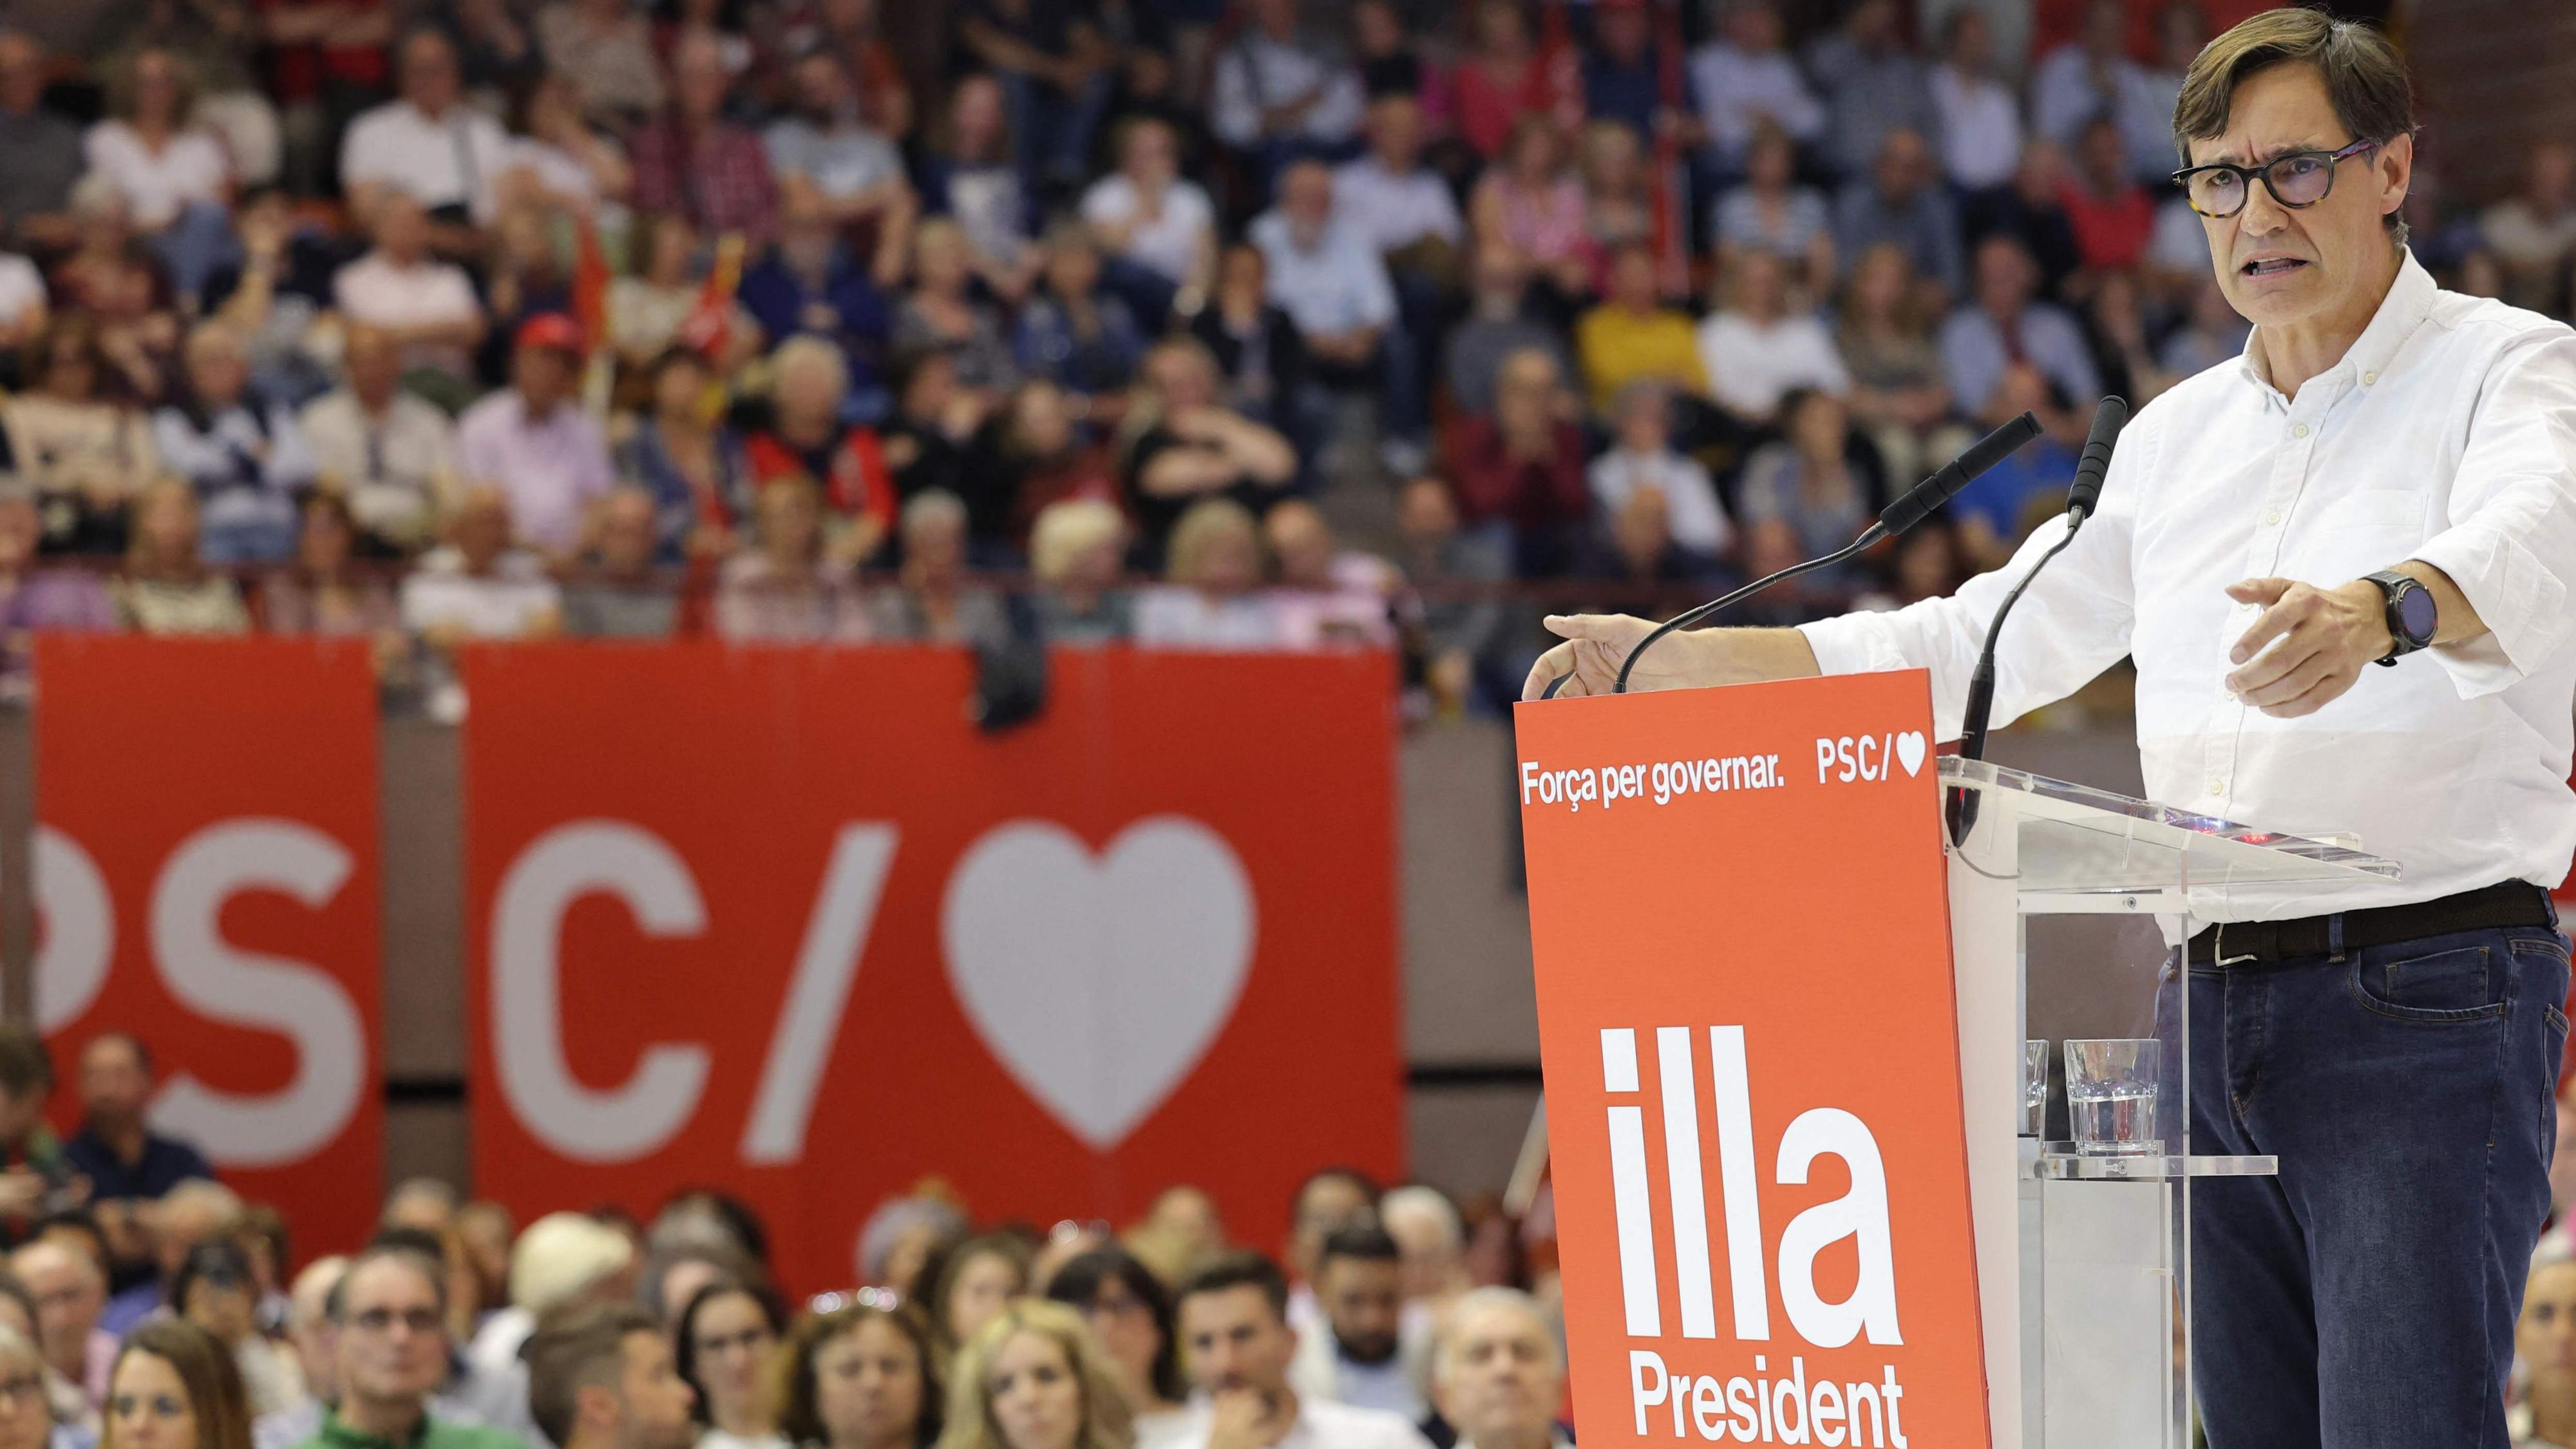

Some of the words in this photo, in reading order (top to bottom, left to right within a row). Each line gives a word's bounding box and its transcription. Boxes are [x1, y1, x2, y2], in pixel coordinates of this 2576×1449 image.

[1521, 761, 1598, 812] Força
[1601, 764, 1647, 809] per
[1651, 754, 1785, 806] governar.
[1600, 1025, 1904, 1349] illa
[1629, 1350, 1908, 1449] President
